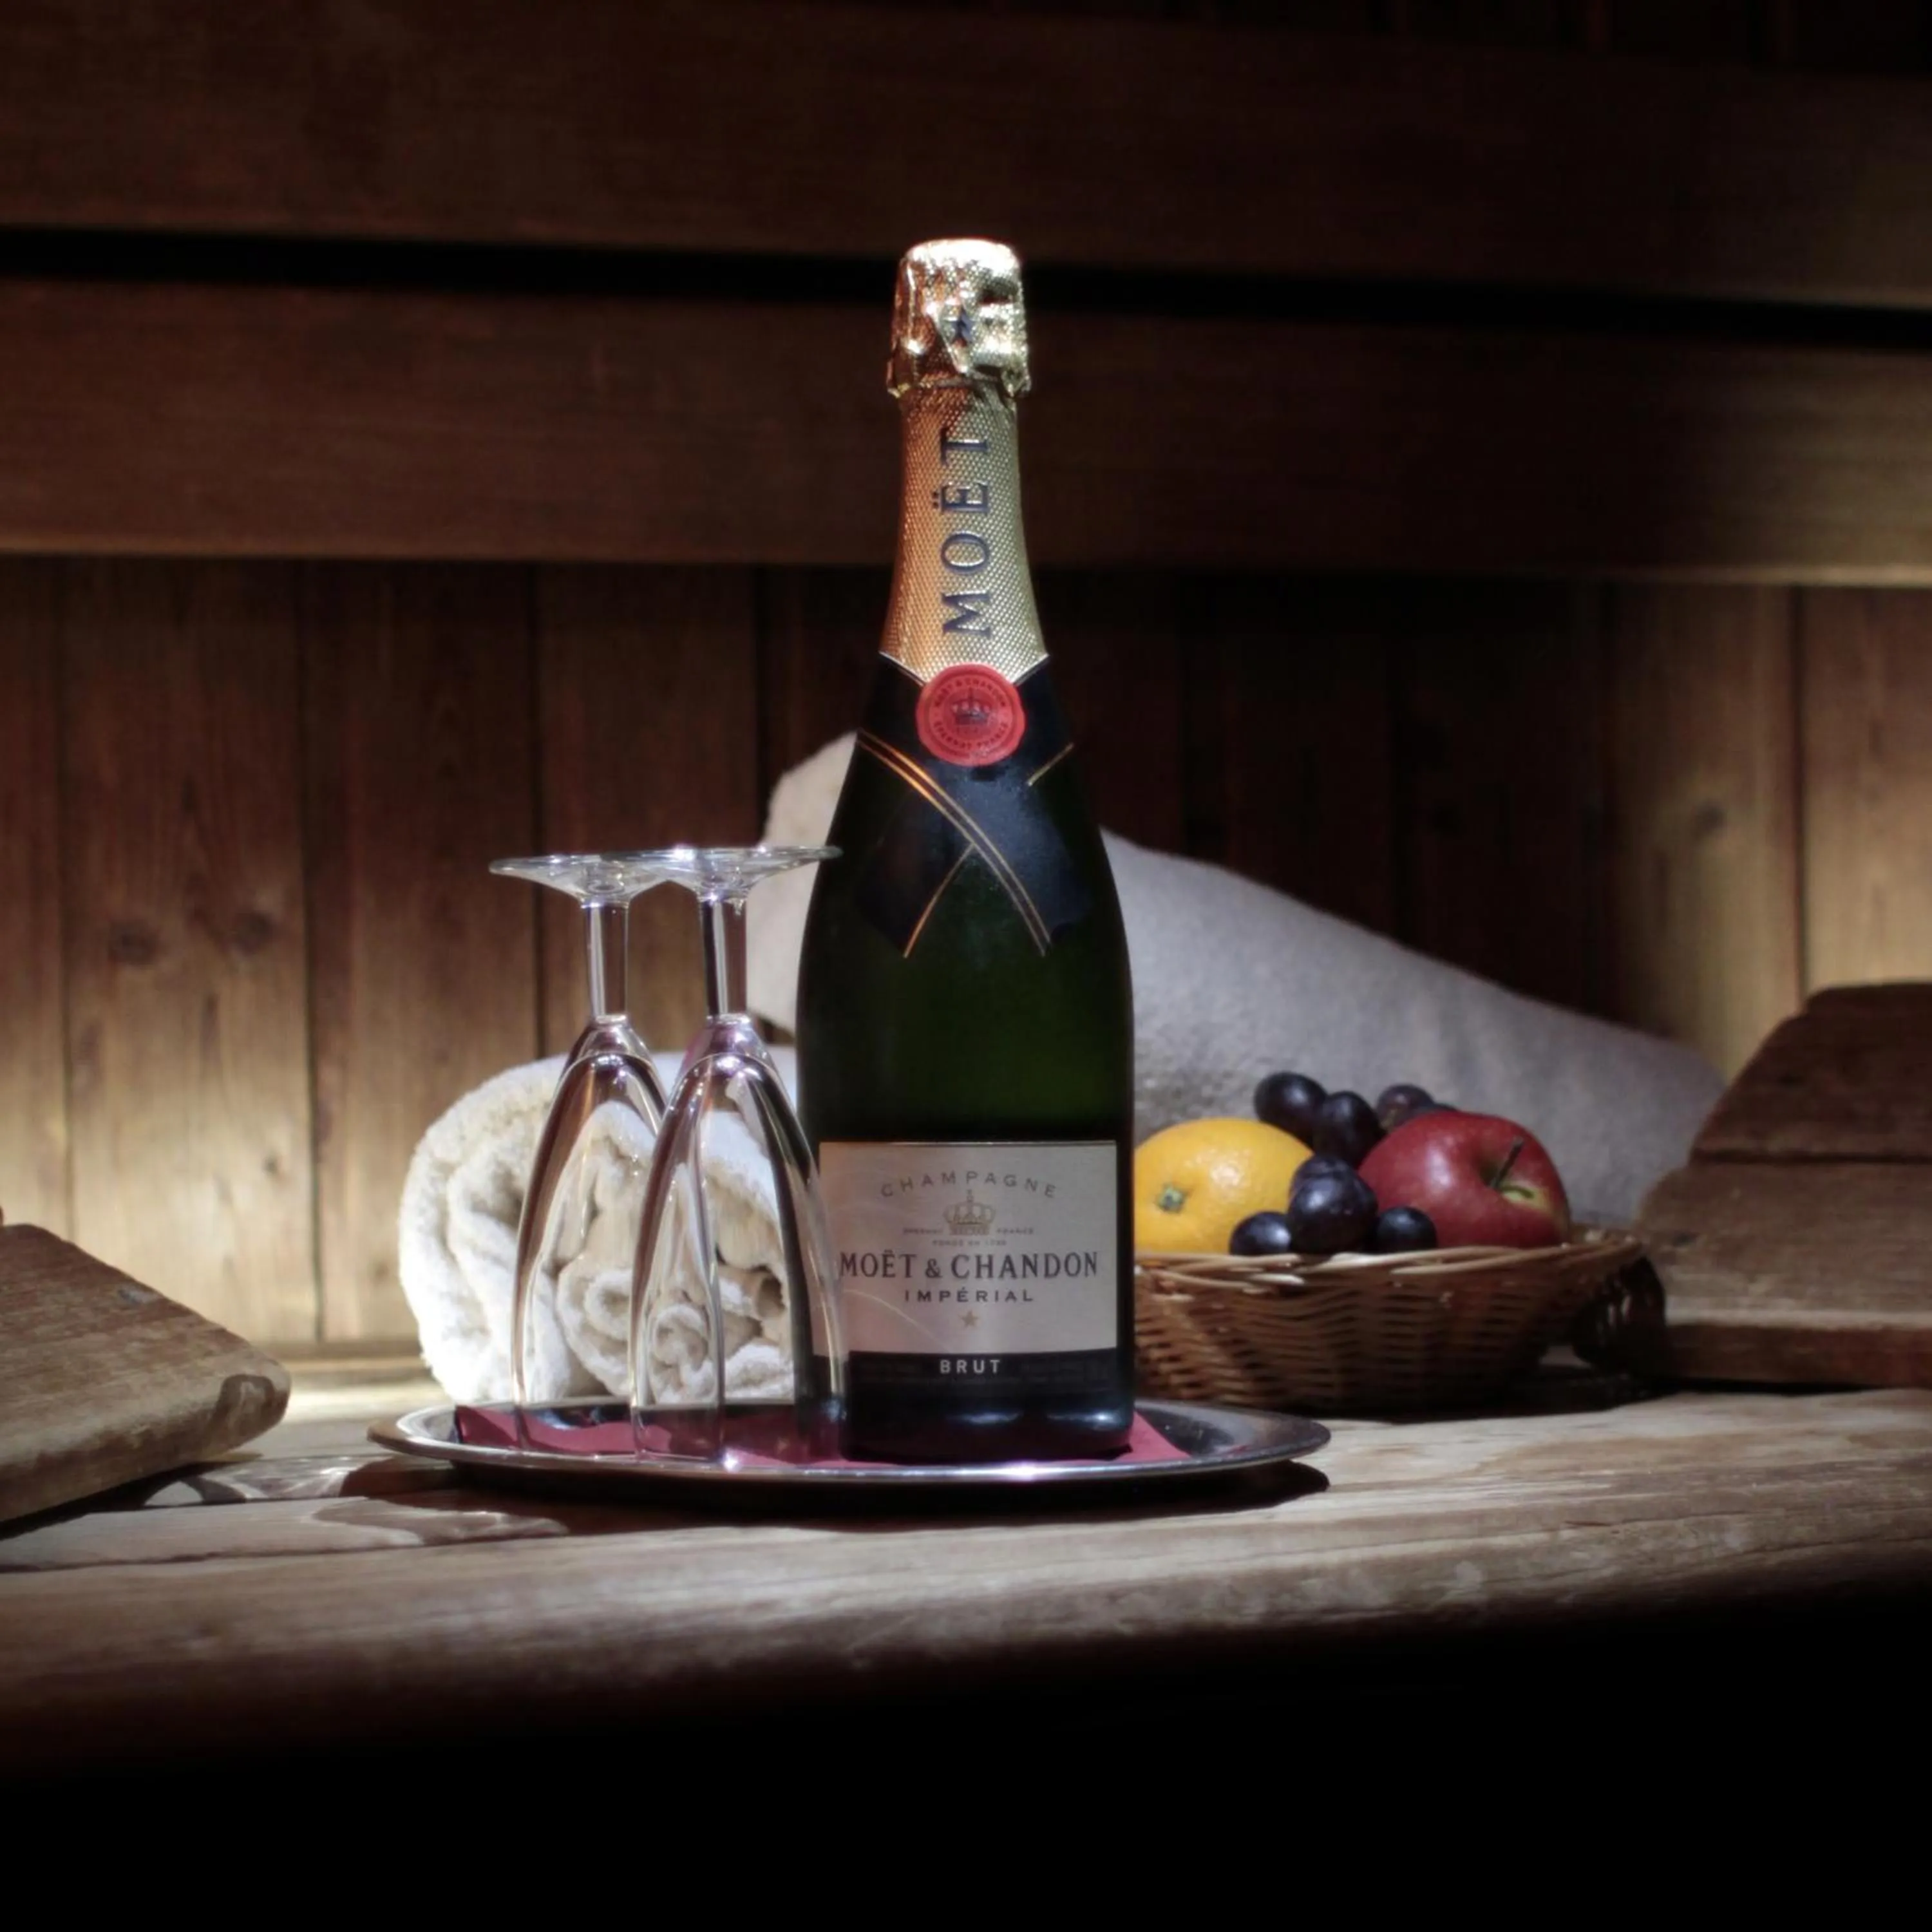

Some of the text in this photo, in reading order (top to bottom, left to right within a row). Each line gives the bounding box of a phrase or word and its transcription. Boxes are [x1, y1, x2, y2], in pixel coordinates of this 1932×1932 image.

[933, 427, 992, 638] MOËT
[881, 1171, 1056, 1198] CHAMPAGNE
[840, 1249, 1098, 1280] MOËT & CHANDON
[905, 1287, 1034, 1303] IMPÉRIAL
[940, 1359, 1001, 1374] BRUT
